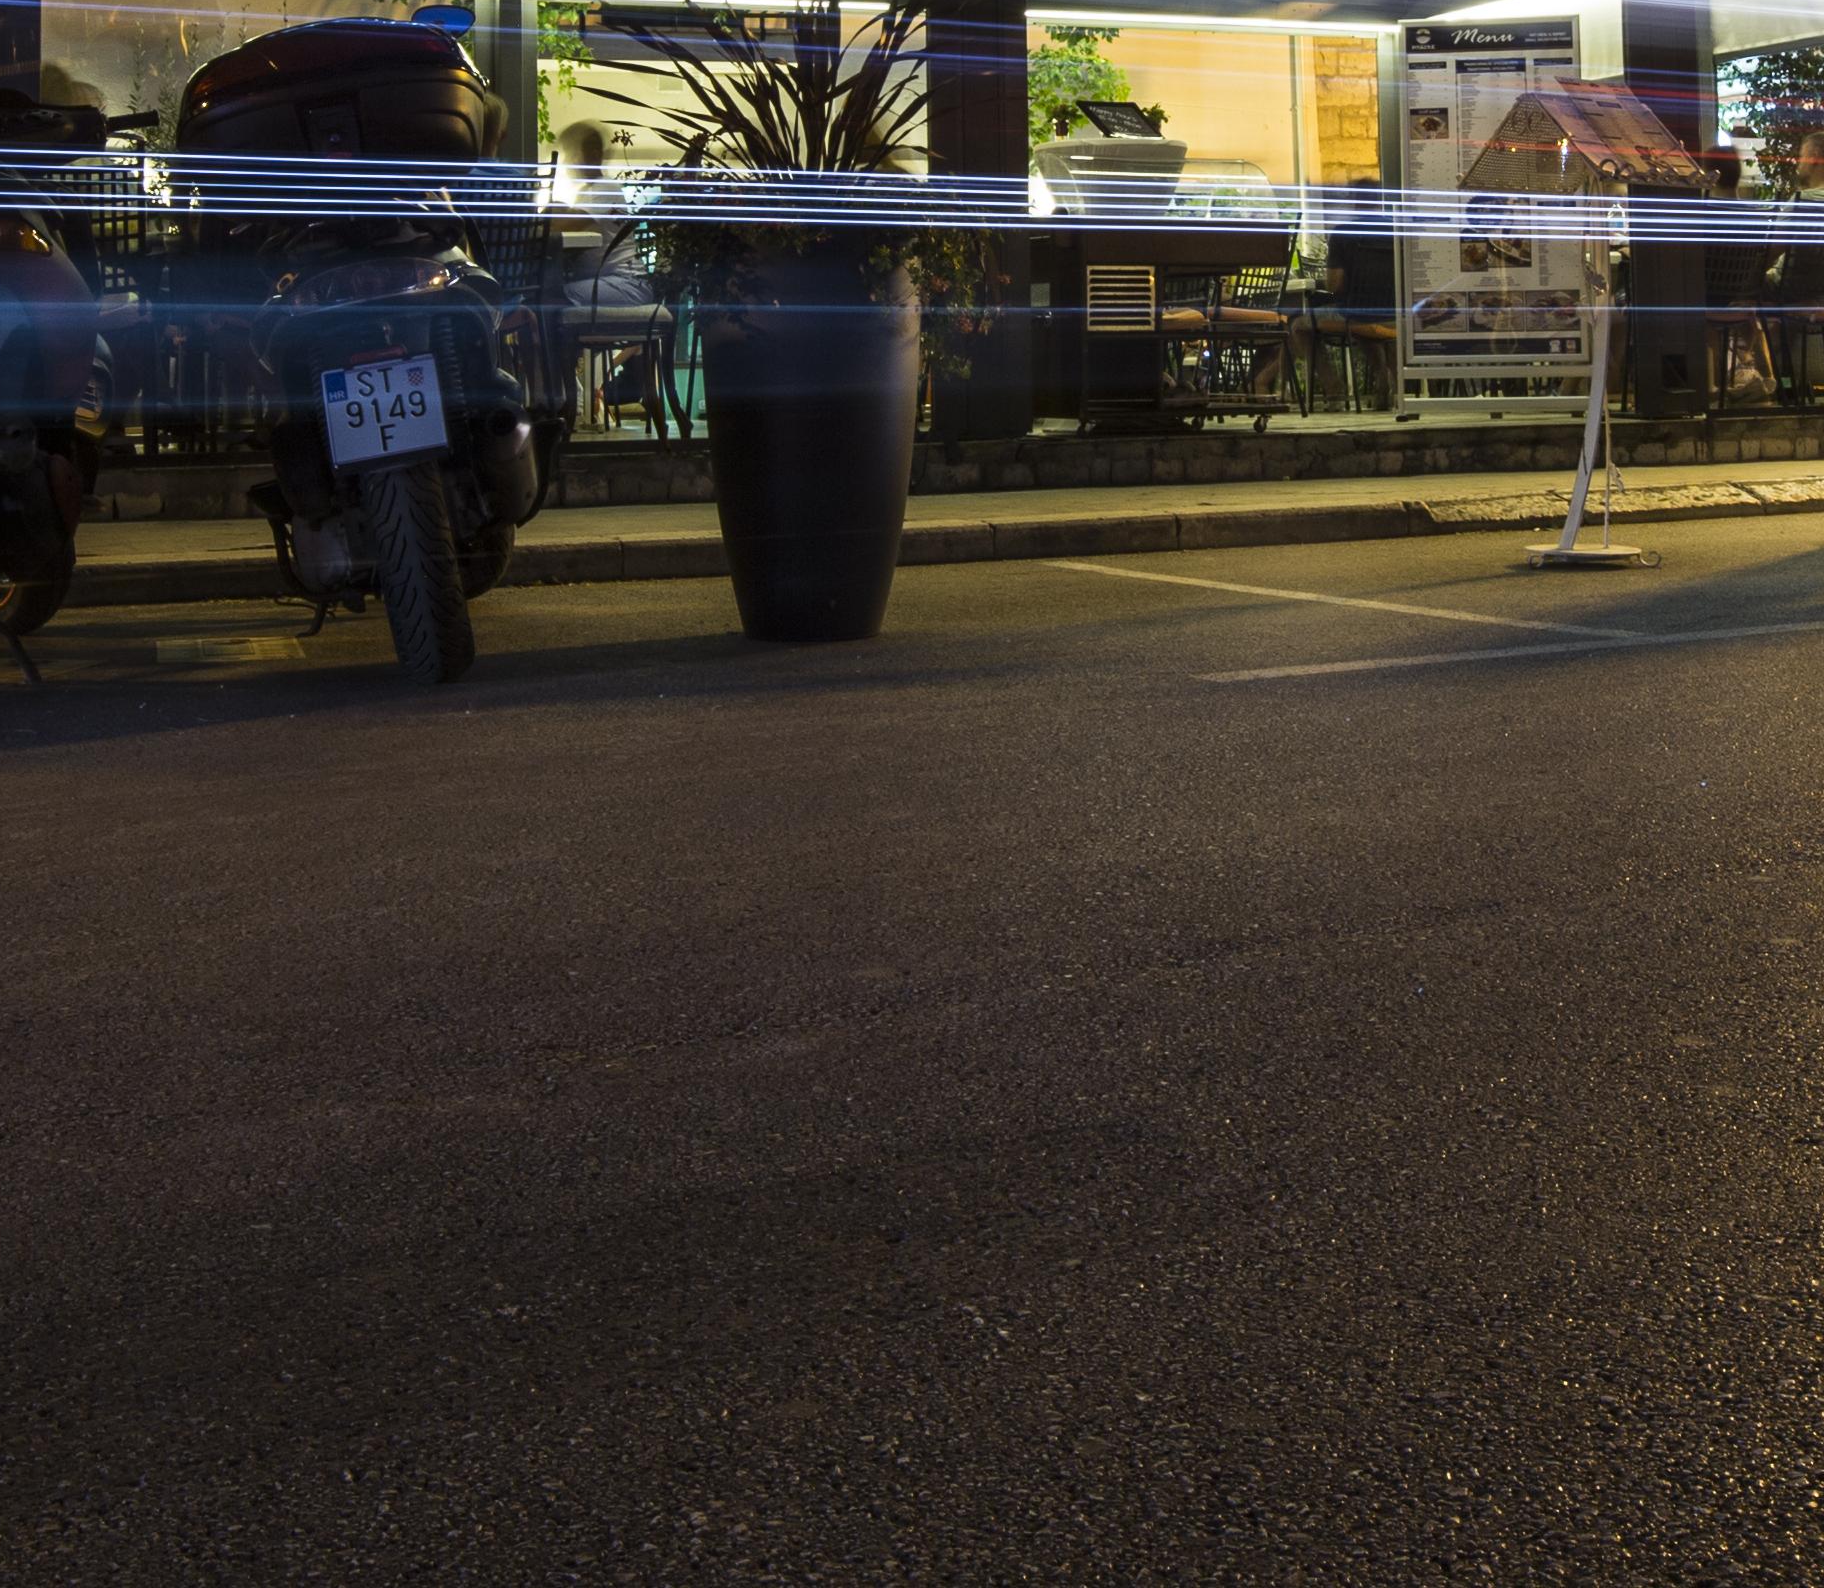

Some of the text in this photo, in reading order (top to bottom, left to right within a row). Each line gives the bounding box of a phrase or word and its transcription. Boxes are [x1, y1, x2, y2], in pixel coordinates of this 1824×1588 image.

[1451, 28, 1515, 45] Menu
[328, 390, 346, 401] HR
[356, 367, 393, 397] ST
[345, 390, 428, 429] 9149
[379, 423, 396, 452] F
